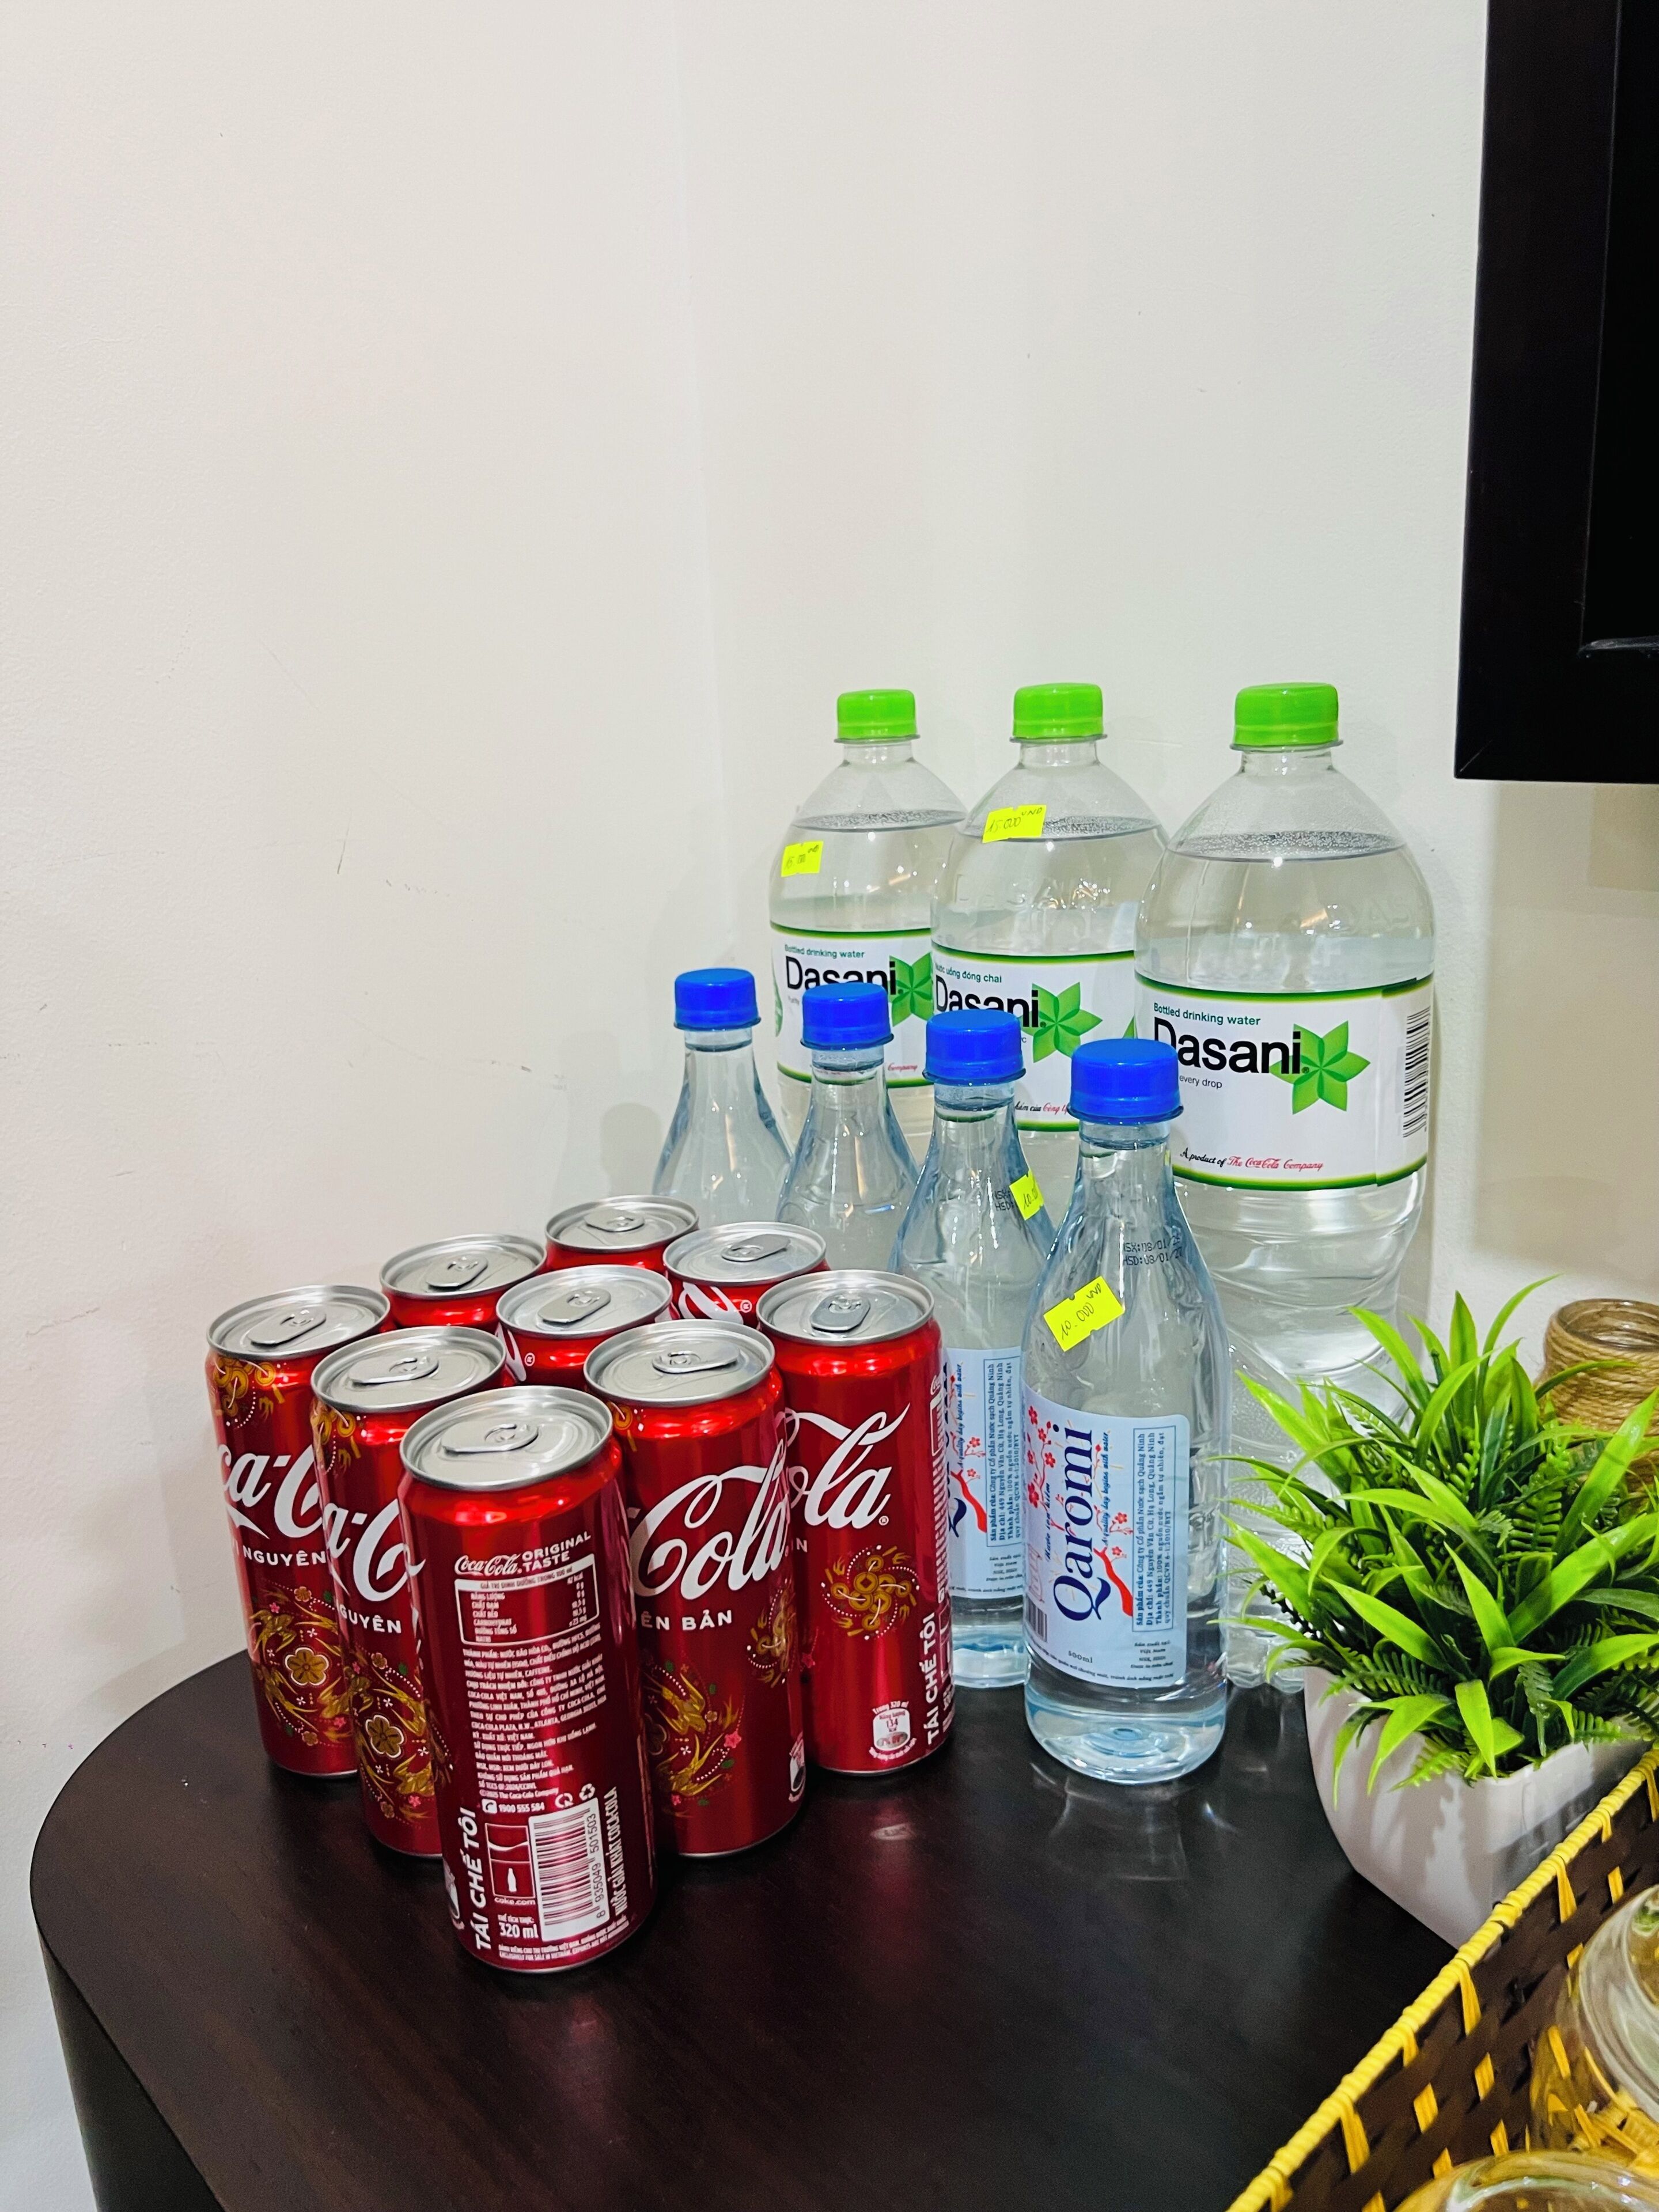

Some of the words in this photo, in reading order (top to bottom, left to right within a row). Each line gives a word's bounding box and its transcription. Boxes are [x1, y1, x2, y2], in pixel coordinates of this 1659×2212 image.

[806, 946, 837, 959] drinking
[962, 971, 980, 983] đóng
[983, 974, 1002, 983] chai
[1154, 1002, 1180, 1017] Bottled
[1183, 1010, 1224, 1025] drinking
[1227, 1015, 1261, 1025] water
[1179, 1074, 1200, 1086] every
[1202, 1077, 1222, 1089] drop
[1180, 1147, 1188, 1159] A
[1189, 1153, 1216, 1164] product
[1217, 1158, 1228, 1168] of
[1227, 1156, 1243, 1167] The
[1283, 1159, 1324, 1172] Company
[1137, 1453, 1146, 1477] Quảng
[1147, 1454, 1156, 1480] Quảng
[1147, 1482, 1156, 1502] Long,
[1052, 1423, 1112, 1622] Qaromi
[243, 1544, 328, 1567] NGUYÊN
[521, 1531, 592, 1562] ORIGINAL
[454, 1554, 521, 1577] Coca-Cola
[522, 1550, 570, 1573] TASTE
[339, 1603, 402, 1634] GUYÊN
[682, 1609, 733, 1631] BẢN
[919, 1612, 936, 1656] TÔI
[919, 1653, 938, 1704] CHẾ
[923, 1705, 940, 1745] TÁI
[499, 1804, 516, 1813] 1900
[517, 1803, 531, 1813] 555
[531, 1802, 546, 1811] 584
[457, 1807, 480, 1849] TÔI
[586, 1812, 600, 1854] 501503
[459, 1848, 486, 1909] CHẾ
[592, 1862, 604, 1903] 935049
[494, 1896, 536, 1906] coke.com
[596, 1910, 606, 1919] 8
[470, 1912, 491, 1950] TÁI
[499, 1923, 521, 1938] 320
[522, 1924, 539, 1938] ml
